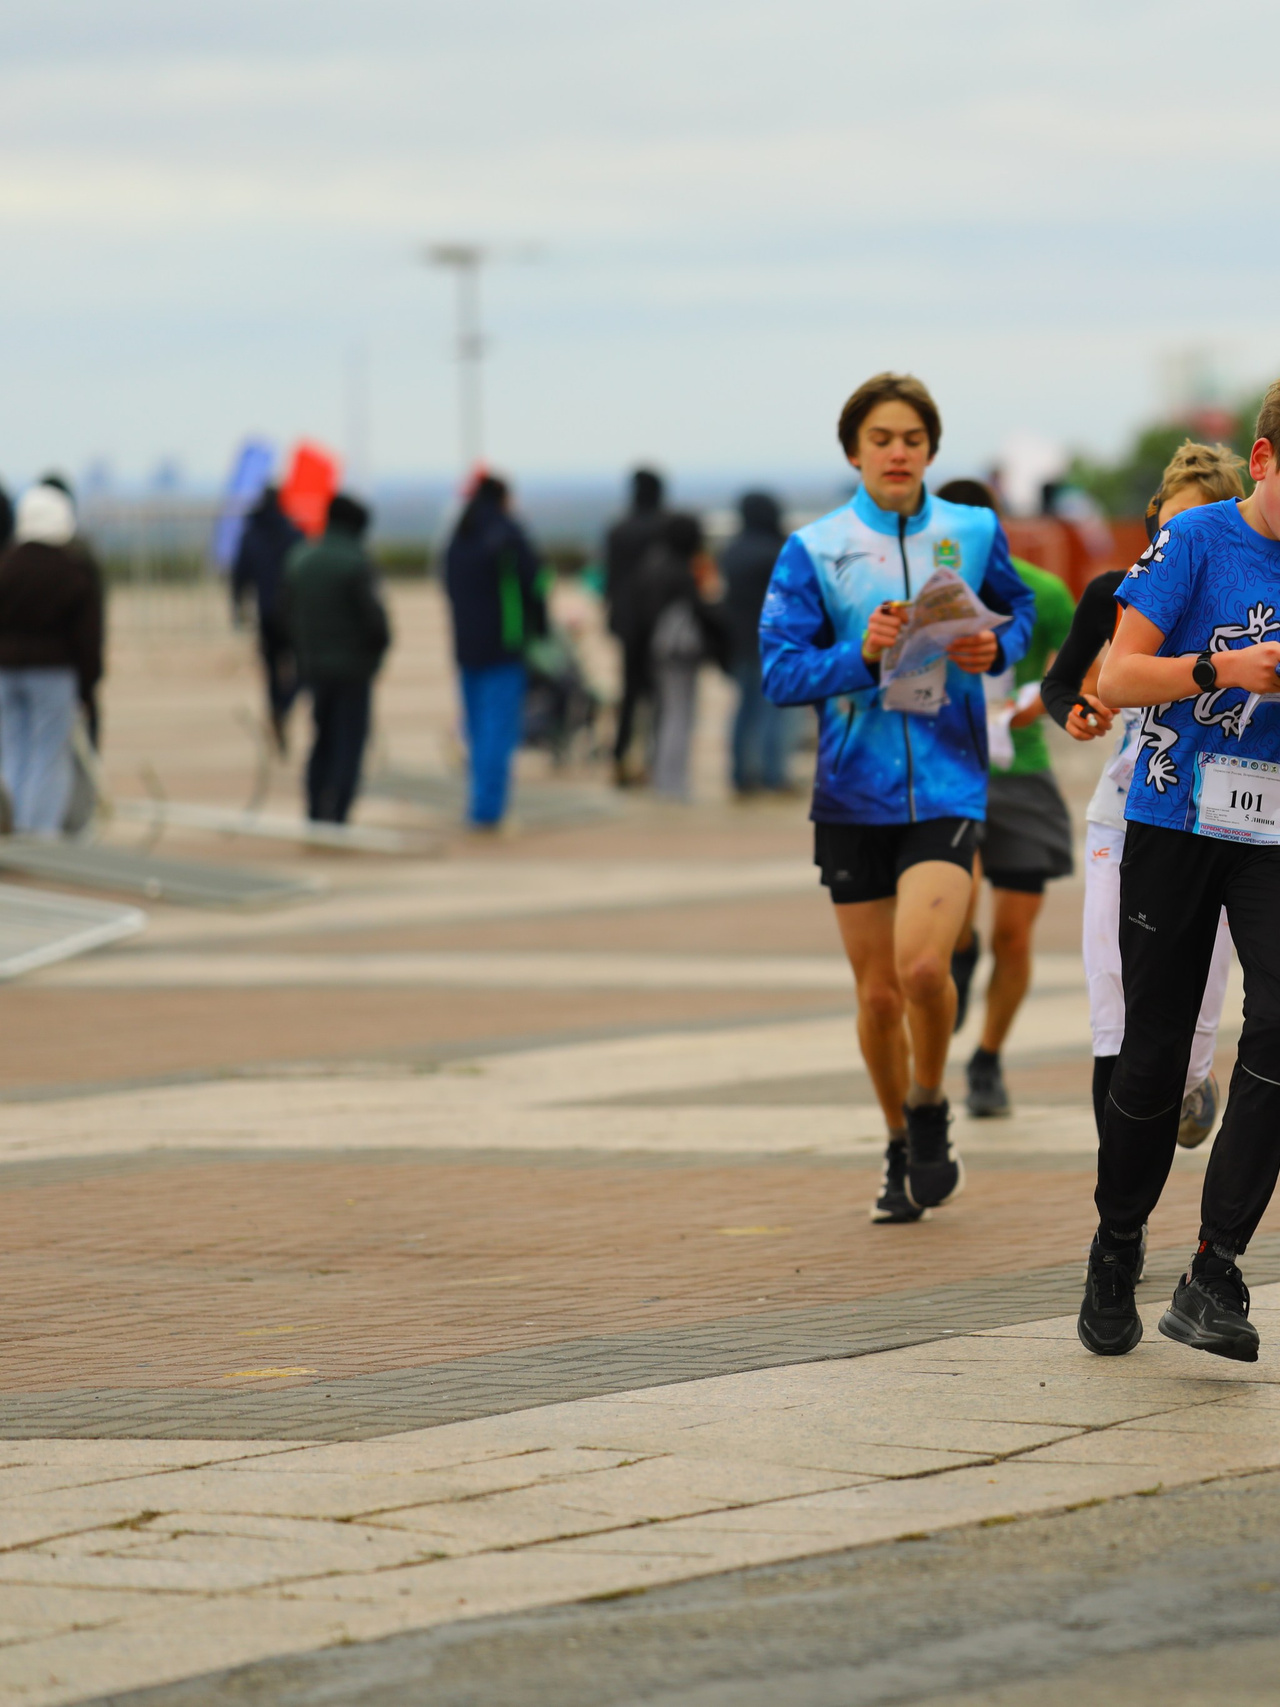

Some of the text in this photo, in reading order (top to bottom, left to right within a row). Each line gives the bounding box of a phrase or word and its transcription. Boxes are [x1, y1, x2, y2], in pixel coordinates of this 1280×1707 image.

[1230, 789, 1263, 813] 101
[1244, 814, 1250, 822] 5
[1251, 816, 1275, 826] линия
[1200, 824, 1252, 837] ПЕРВЕНСТВО РОССИИ
[1128, 915, 1156, 932] NORDSKI
